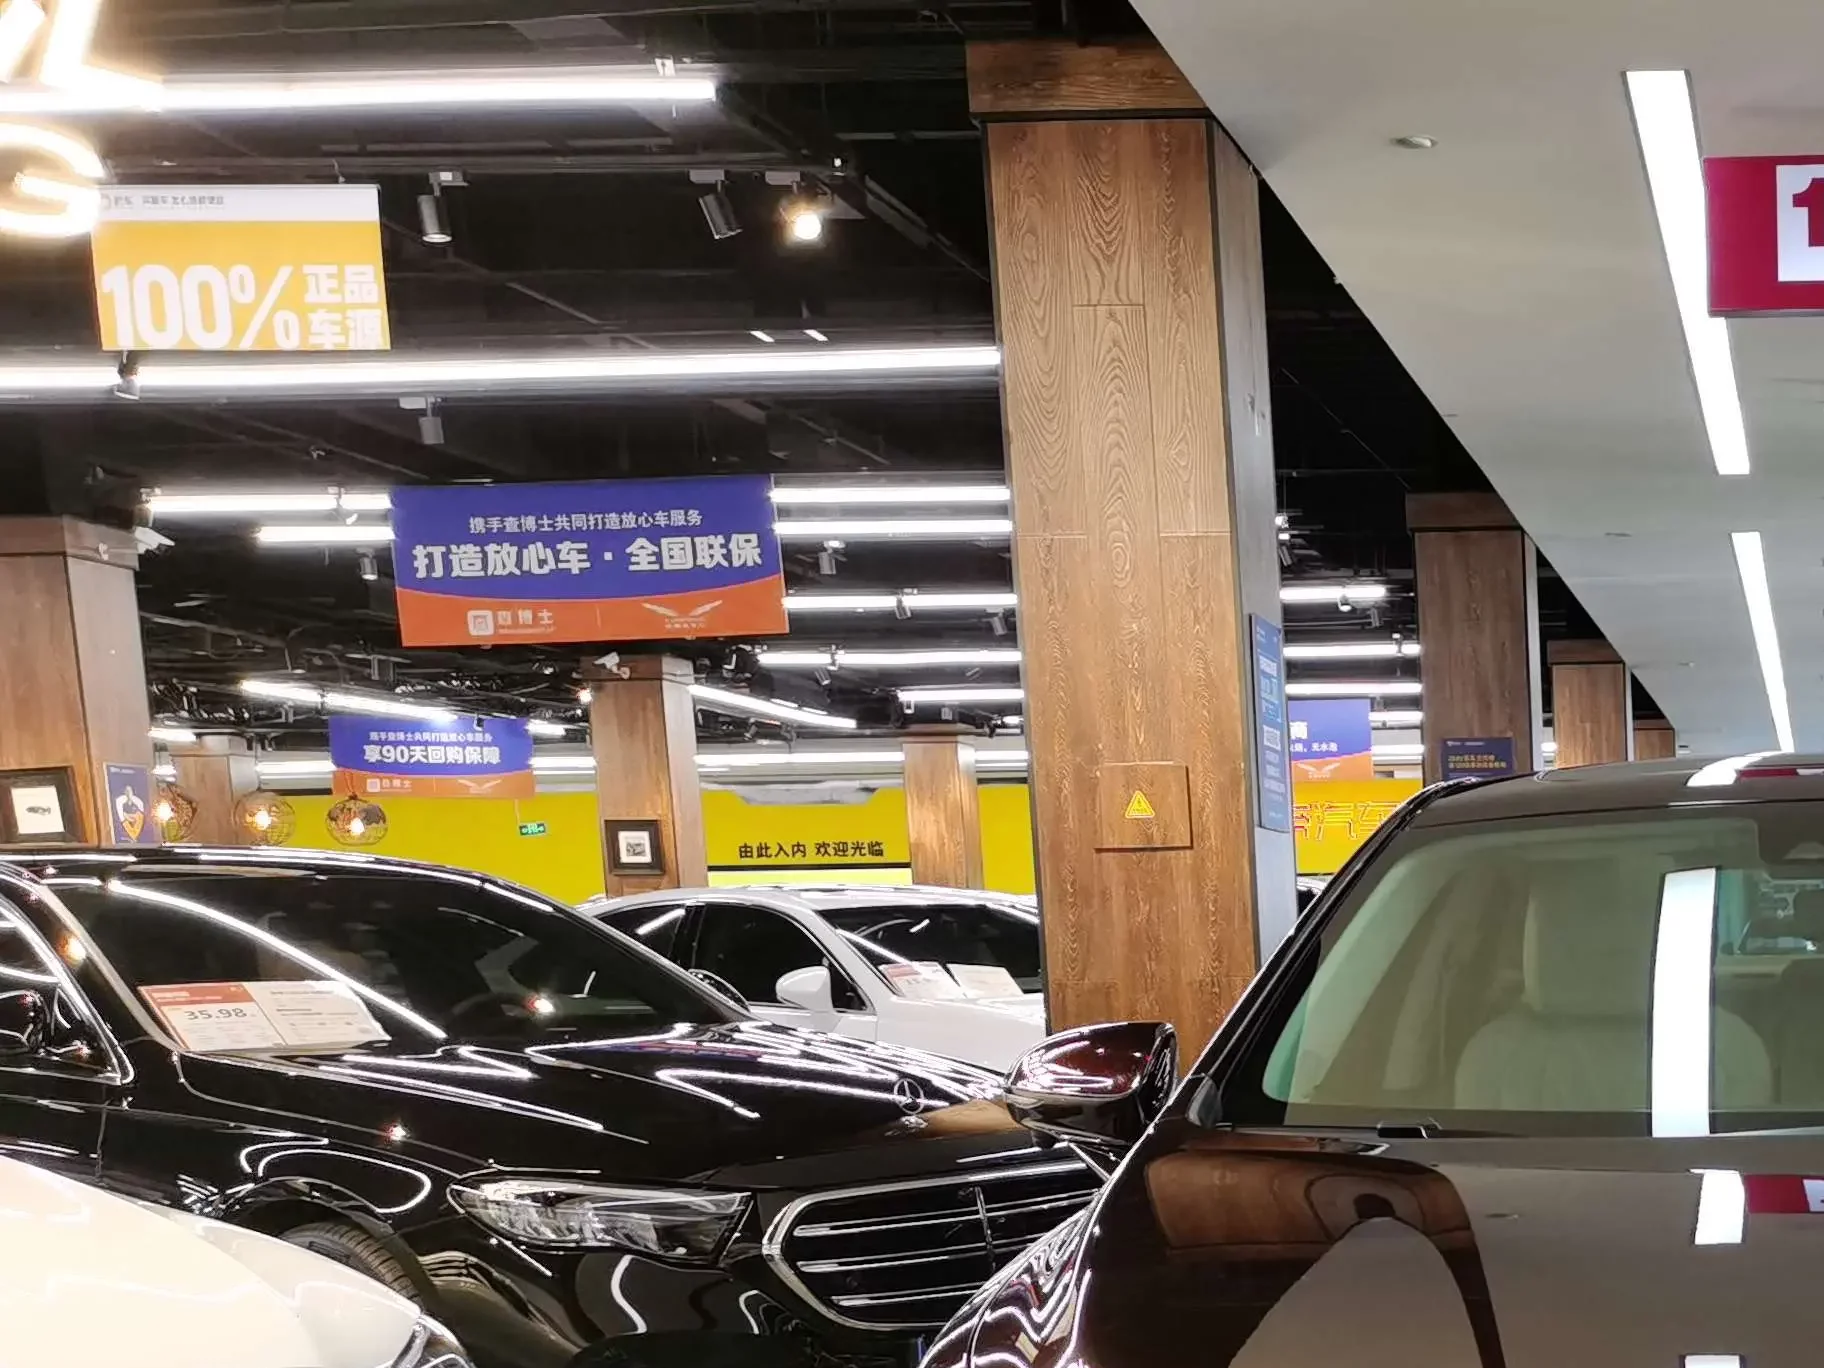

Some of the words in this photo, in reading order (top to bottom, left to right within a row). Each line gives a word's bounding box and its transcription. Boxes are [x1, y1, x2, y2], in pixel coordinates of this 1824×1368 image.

[302, 265, 379, 304] 正品
[101, 264, 300, 350] 100%
[307, 309, 382, 350] 车源
[468, 509, 703, 534] 携手查博士共同打造放心车服务
[363, 744, 501, 765] 享90天回购保障
[739, 842, 807, 859] 由此入内
[815, 841, 884, 858] 欢迎光临
[184, 1007, 248, 1020] 35.98
